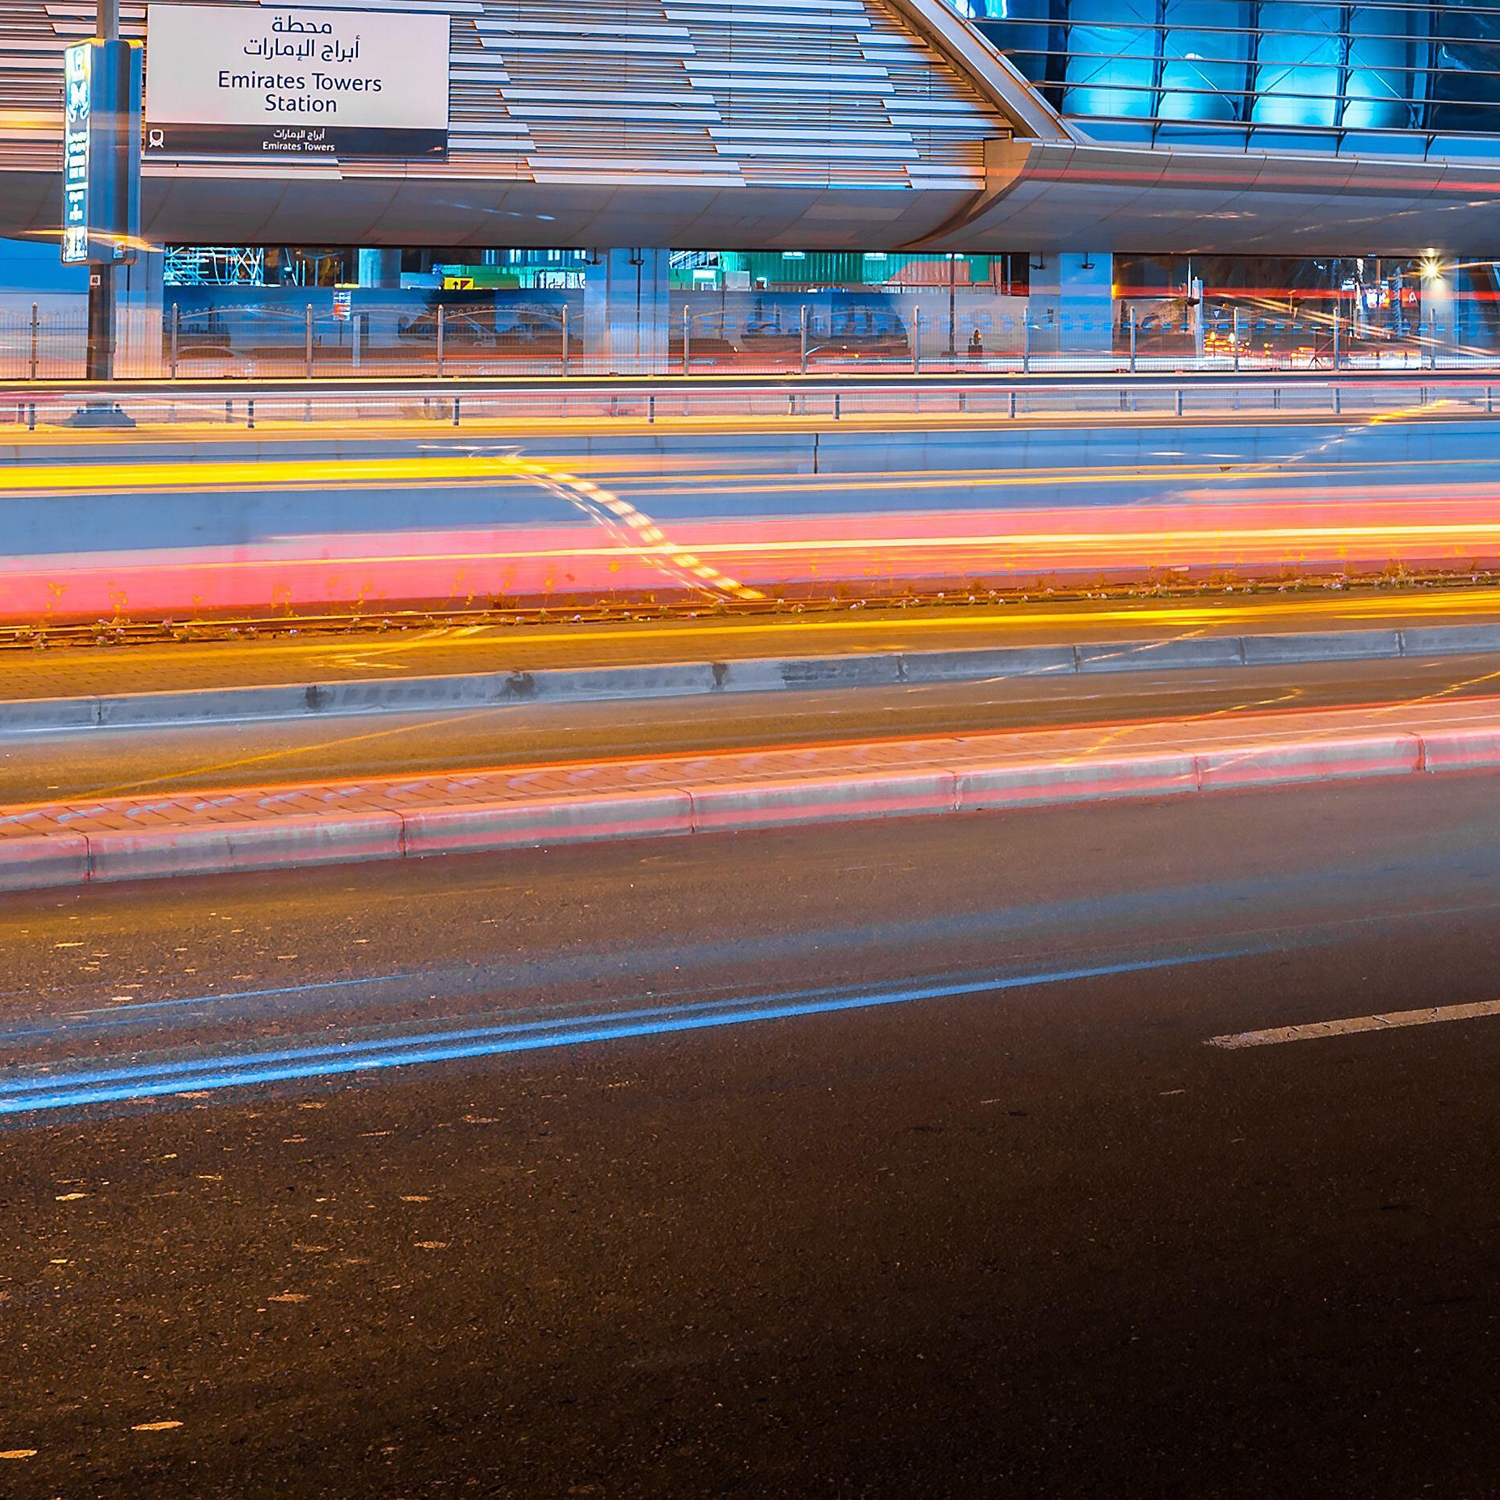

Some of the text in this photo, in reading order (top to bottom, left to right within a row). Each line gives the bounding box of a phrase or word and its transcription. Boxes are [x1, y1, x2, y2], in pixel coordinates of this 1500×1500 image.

[271, 15, 332, 34] محطة
[243, 34, 360, 62] أبراج الإمارات
[218, 71, 382, 92] Emirates Towers
[265, 94, 337, 112] Station
[262, 141, 335, 151] Emirates Towers
